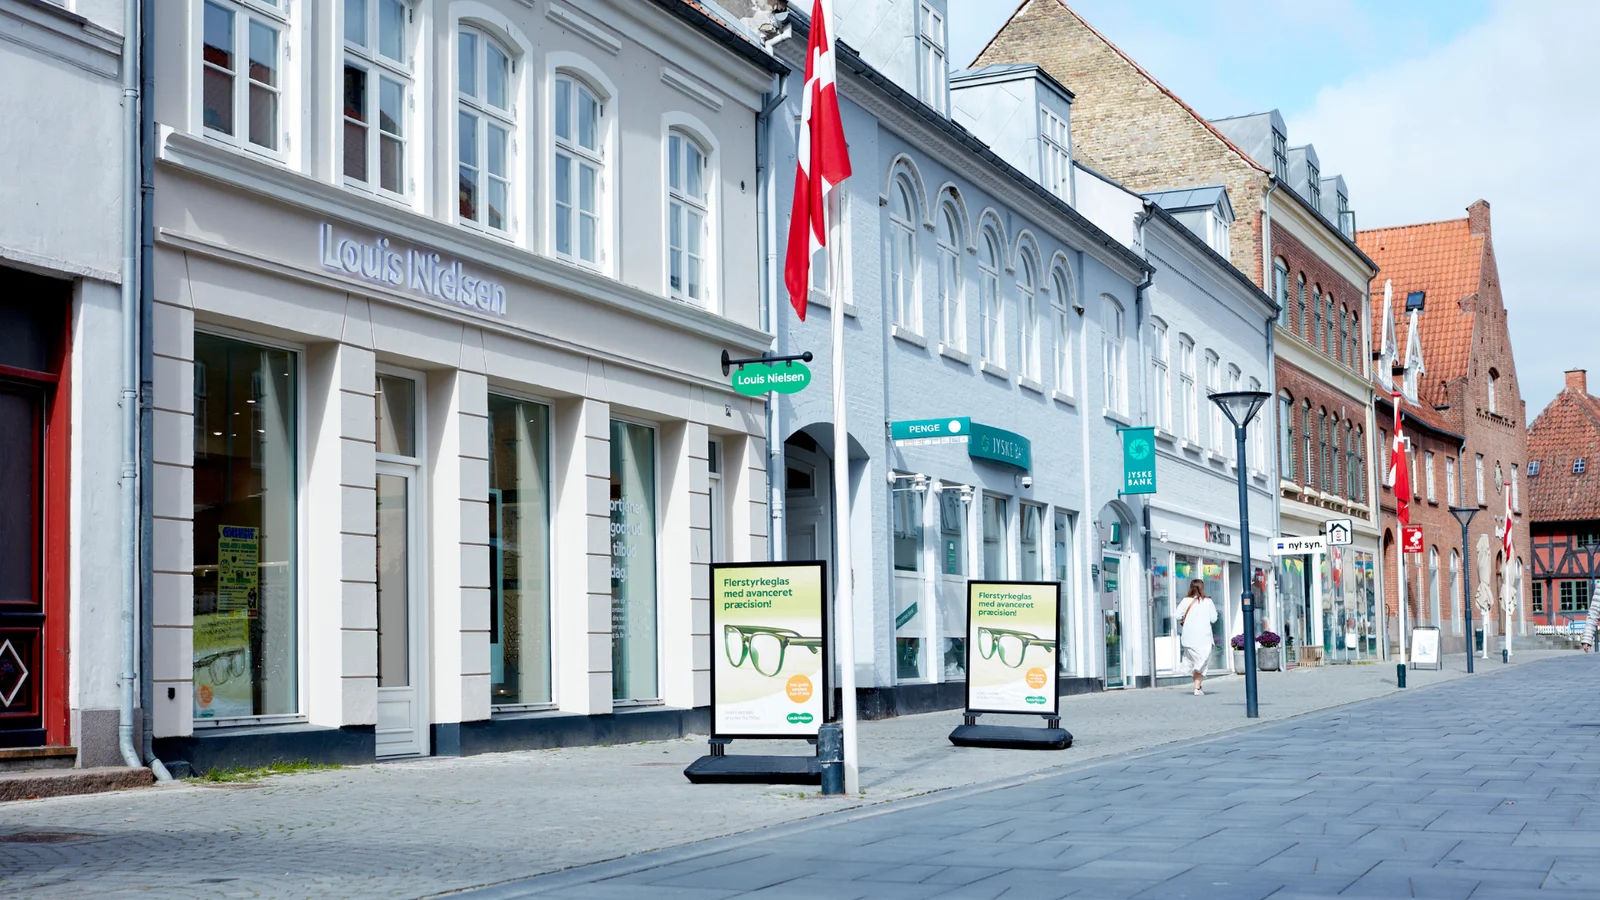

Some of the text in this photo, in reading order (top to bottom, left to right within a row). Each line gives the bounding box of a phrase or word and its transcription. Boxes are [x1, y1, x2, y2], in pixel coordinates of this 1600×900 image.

[321, 222, 508, 315] Louis Nielsen
[738, 372, 805, 385] Louis Nielsen
[909, 423, 940, 433] PENGE
[992, 437, 1014, 457] JYSKE
[610, 497, 644, 516] ortjener
[612, 540, 637, 558] tilbud
[1288, 541, 1302, 550] nyt
[1304, 542, 1322, 550] syn.
[724, 577, 790, 588] Flerstyrkeglas
[724, 588, 793, 598] med avanceret
[978, 592, 1032, 601] Flerstyrkeglas
[724, 600, 772, 610] præcision!
[978, 600, 995, 608] med
[978, 609, 1017, 617] præcision!
